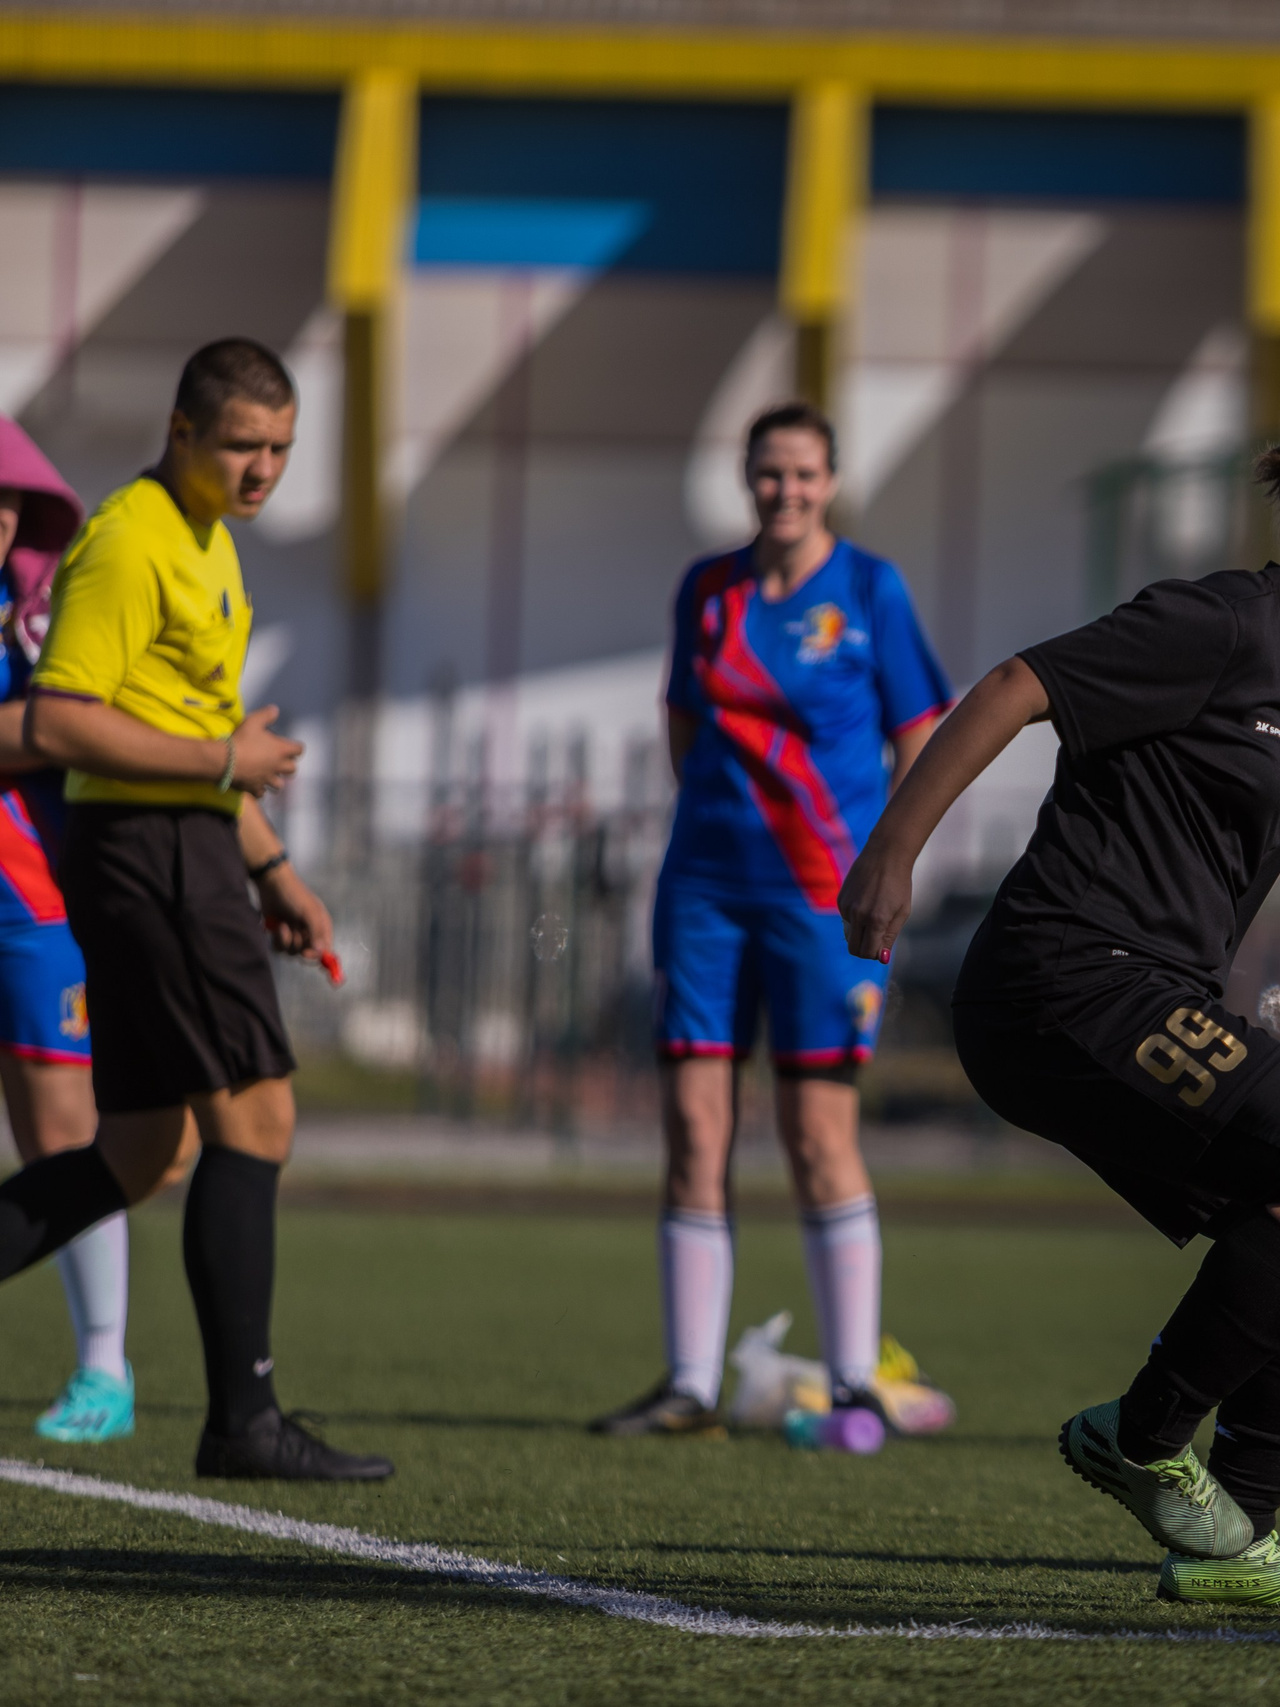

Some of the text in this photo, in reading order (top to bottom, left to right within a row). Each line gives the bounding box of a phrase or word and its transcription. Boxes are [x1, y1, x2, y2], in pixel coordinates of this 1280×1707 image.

[1255, 720, 1270, 733] 2K
[1136, 1007, 1248, 1107] 99
[1191, 1578, 1261, 1588] NEMESIS
